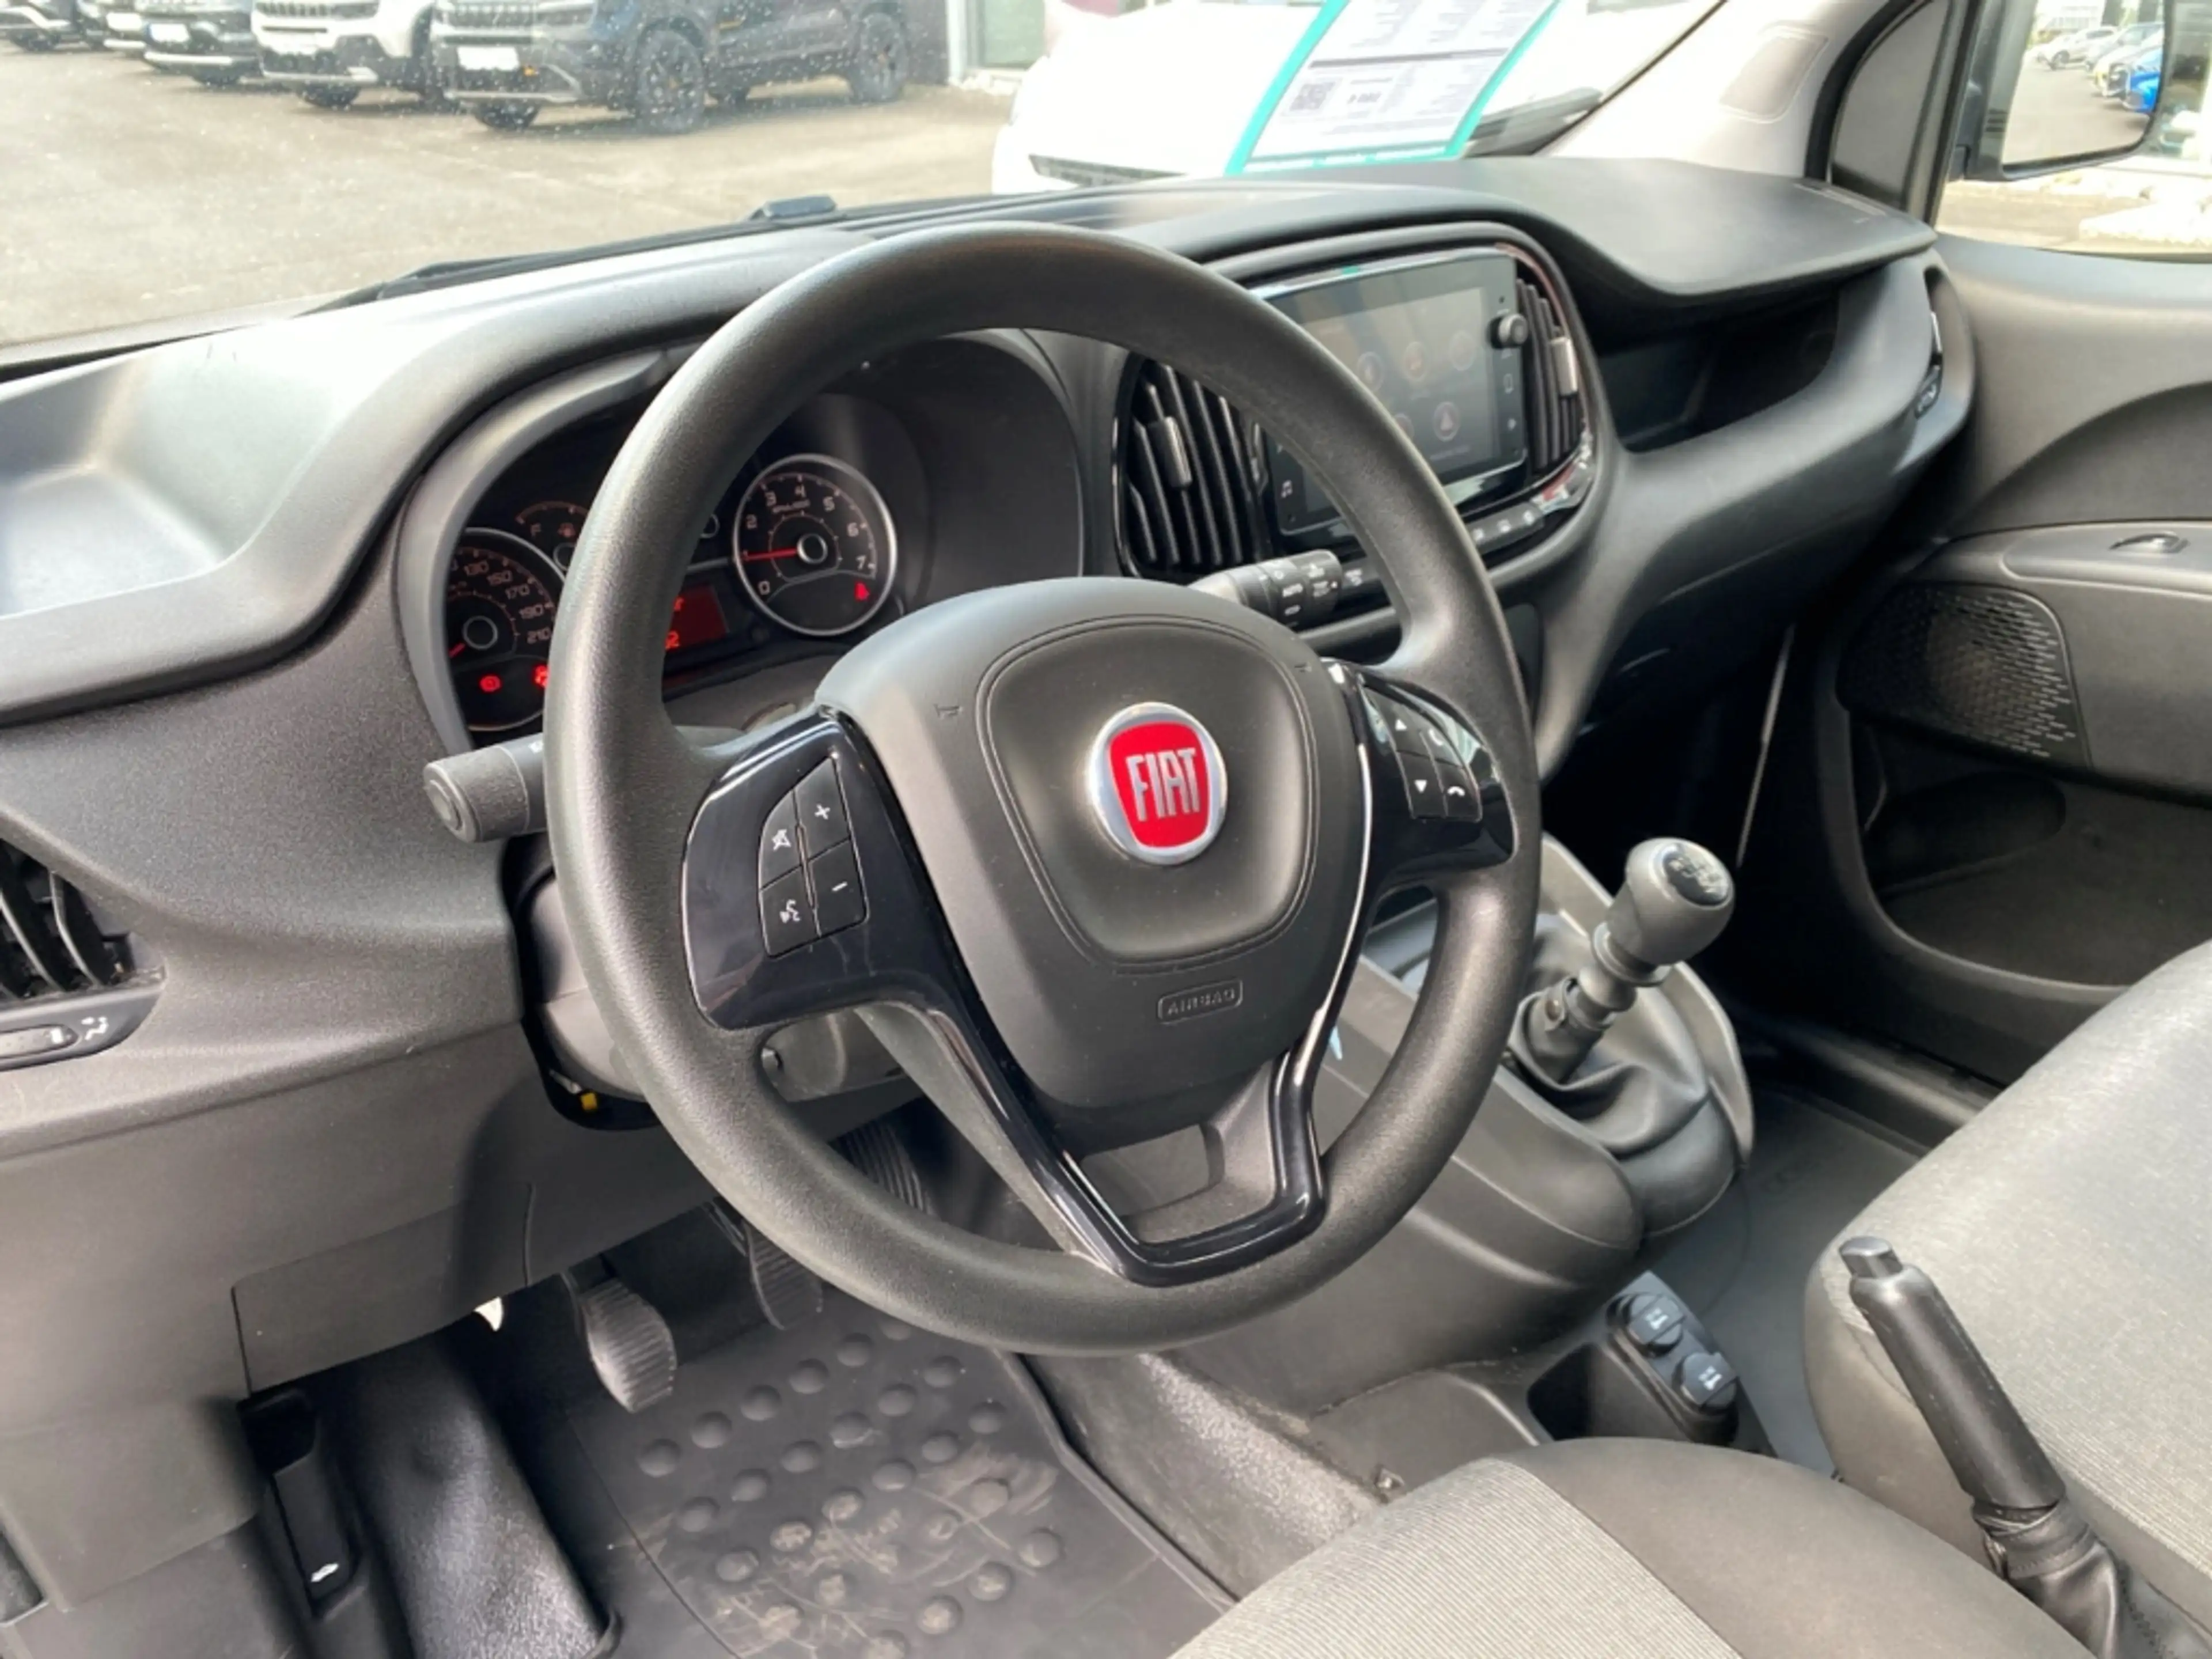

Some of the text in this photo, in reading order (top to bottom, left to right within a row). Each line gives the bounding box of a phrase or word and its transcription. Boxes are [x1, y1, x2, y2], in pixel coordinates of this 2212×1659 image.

[765, 491, 777, 507] 3
[823, 497, 836, 512] 5
[746, 515, 757, 529] 2
[847, 522, 859, 537] 6
[464, 560, 489, 576] 130
[856, 555, 867, 570] 7
[487, 570, 512, 585] 150
[520, 604, 544, 619] 190
[527, 627, 551, 644] 210
[1125, 747, 1202, 822] FIAT
[1167, 987, 1236, 1016] AIRBAG
